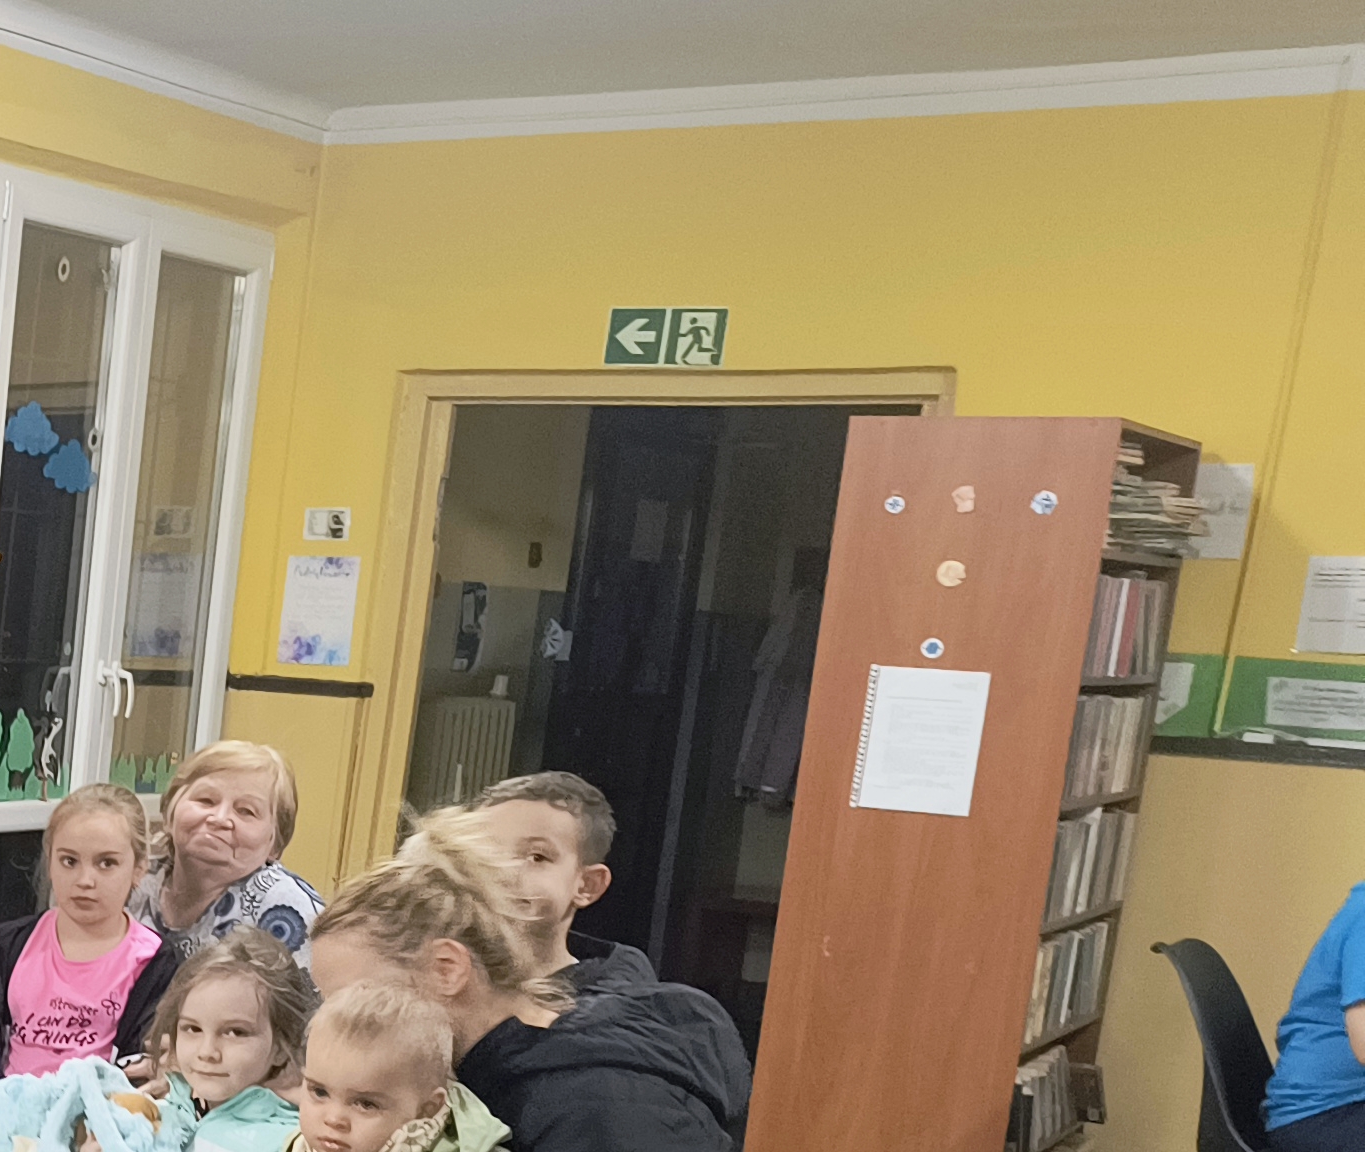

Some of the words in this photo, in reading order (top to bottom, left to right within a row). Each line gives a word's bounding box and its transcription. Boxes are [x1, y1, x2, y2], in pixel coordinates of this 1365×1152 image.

[37, 1016, 65, 1028] CAN
[66, 1016, 92, 1028] DO
[32, 1029, 98, 1046] THINGS
